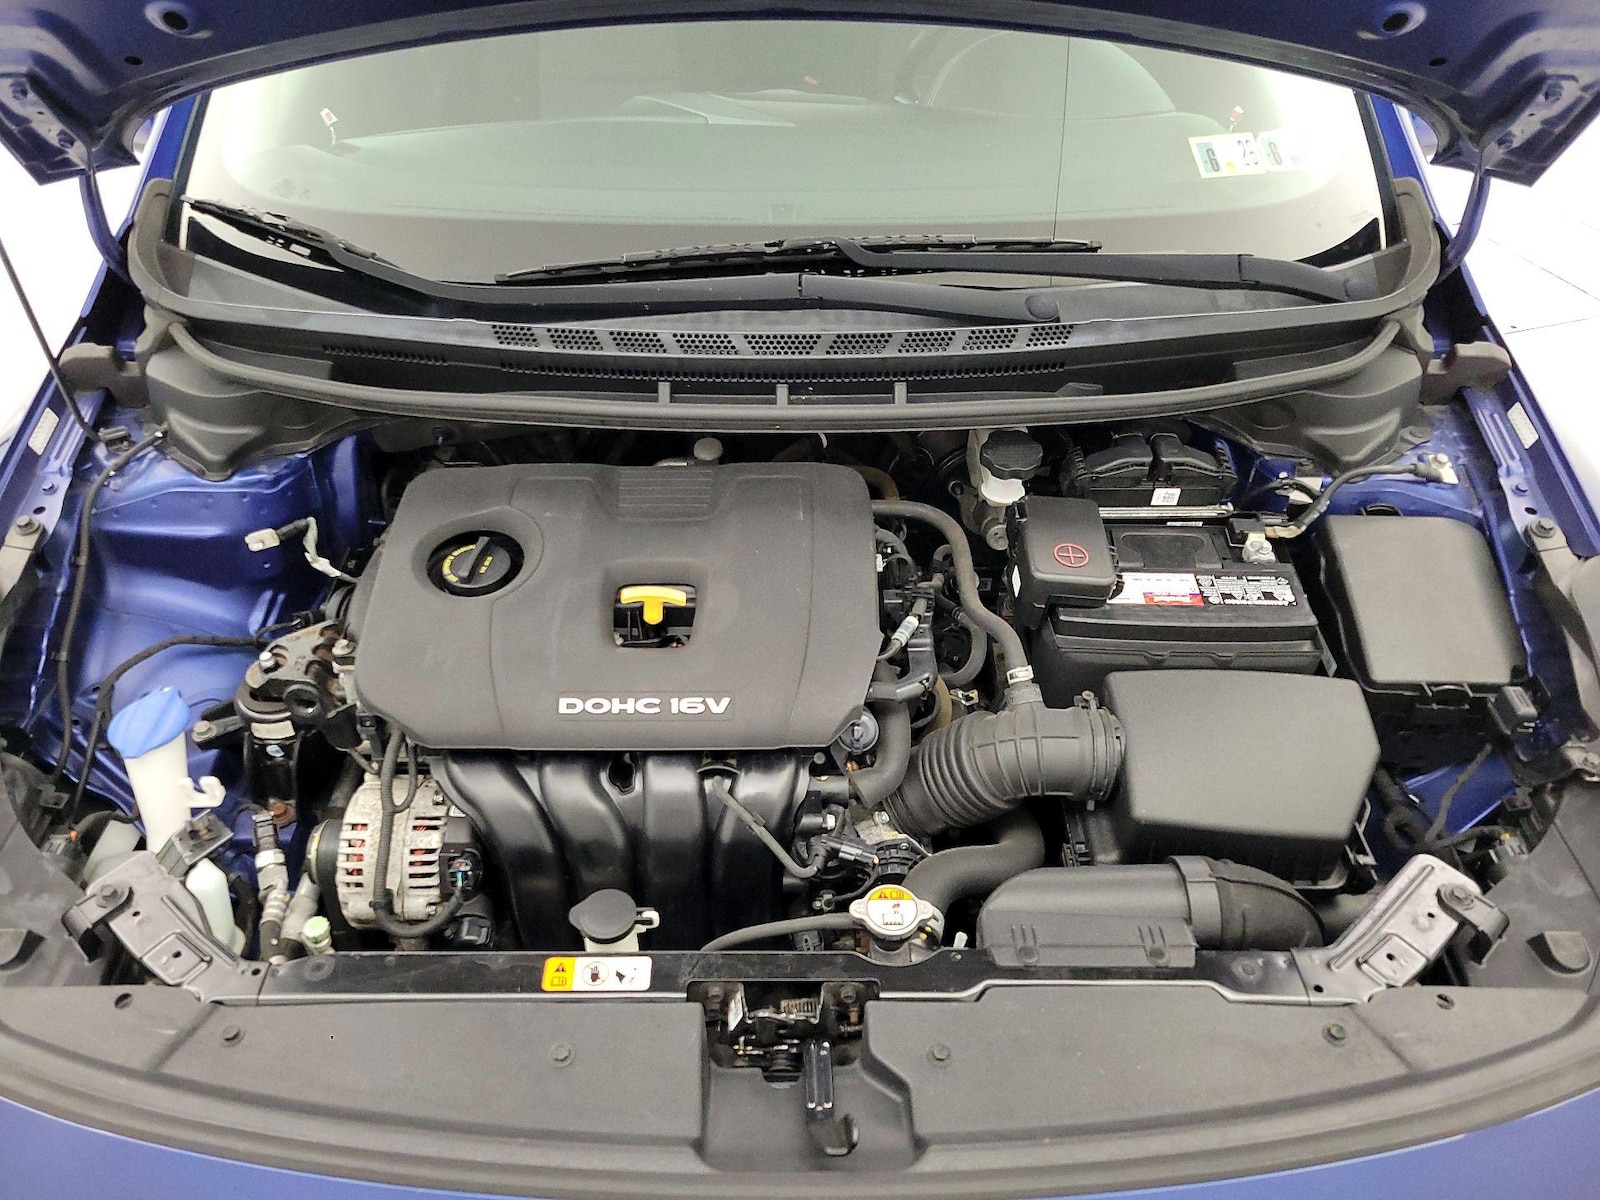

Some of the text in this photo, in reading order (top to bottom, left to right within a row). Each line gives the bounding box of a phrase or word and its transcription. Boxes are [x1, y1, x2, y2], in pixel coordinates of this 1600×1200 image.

[1206, 148, 1220, 172] 6
[1268, 142, 1283, 165] 6
[558, 697, 731, 714] DOHC 16V
